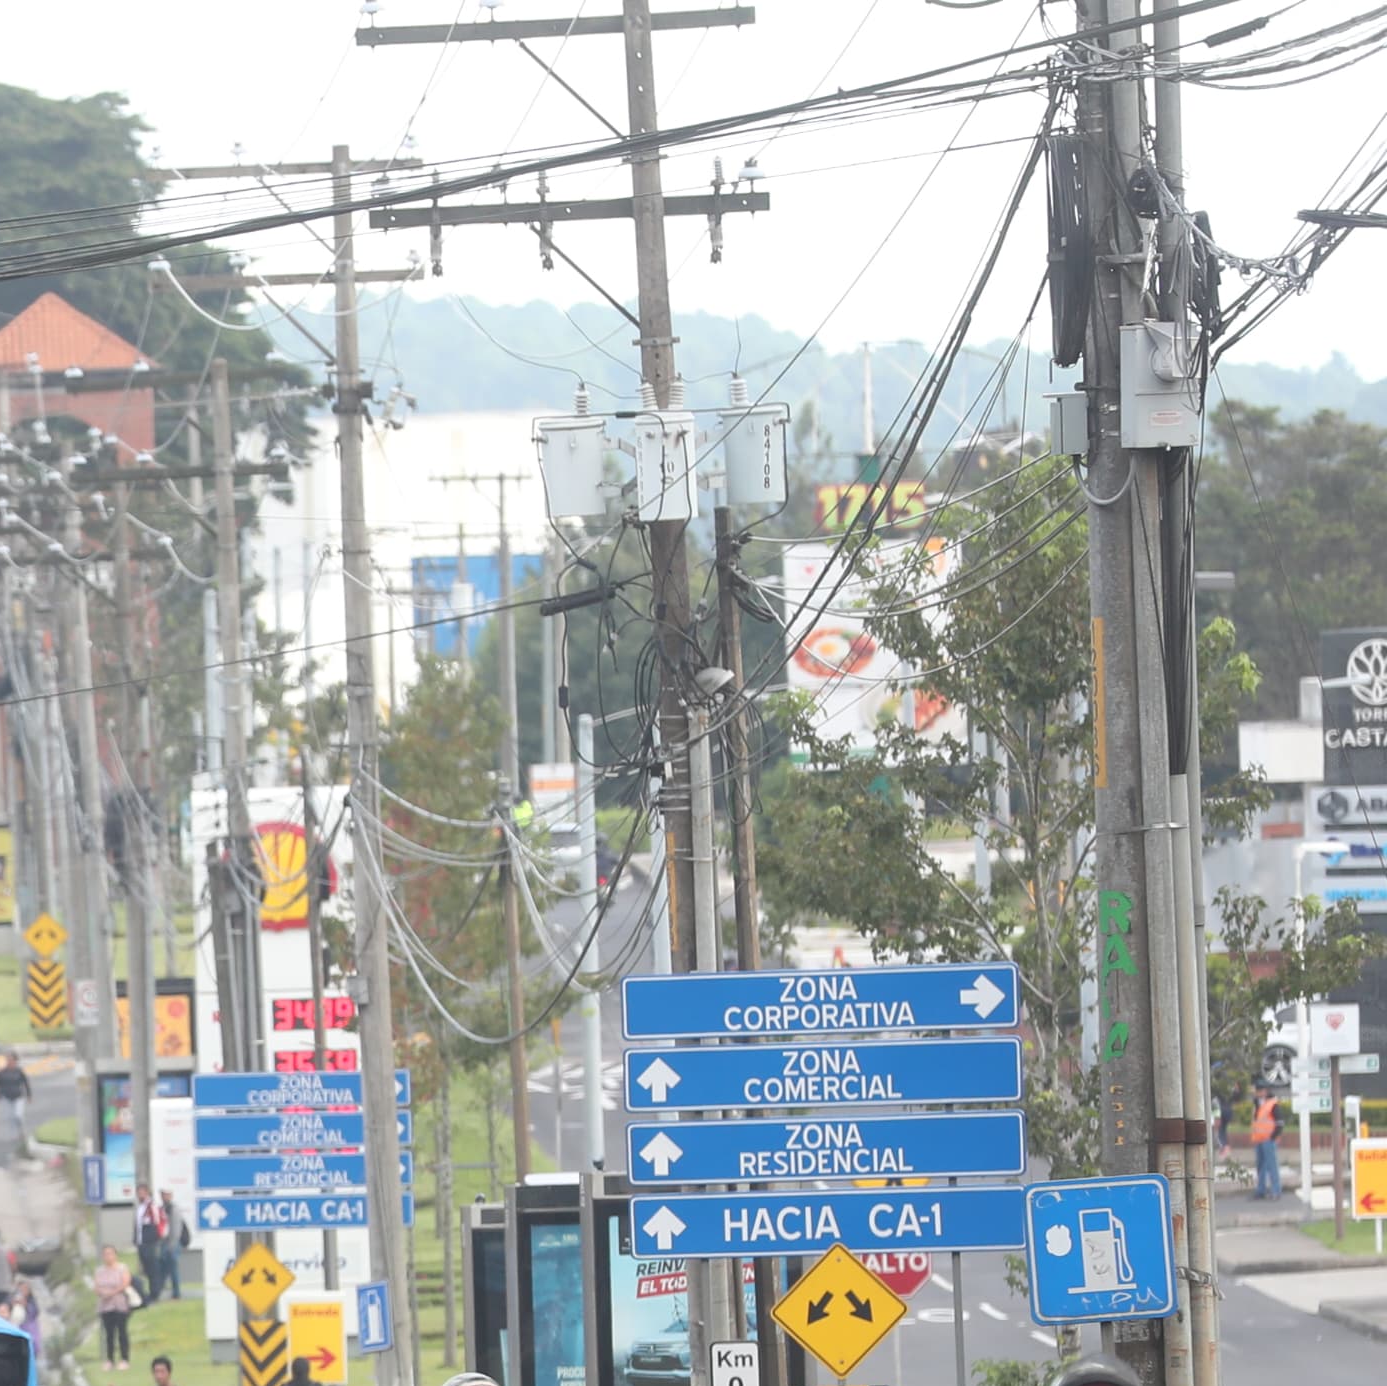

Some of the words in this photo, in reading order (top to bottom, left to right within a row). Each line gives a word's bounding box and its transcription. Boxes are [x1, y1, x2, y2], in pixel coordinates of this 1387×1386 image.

[763, 424, 771, 489] 84108
[779, 976, 857, 1002] ZONA
[724, 1001, 915, 1031] CORPORATIVA
[783, 1049, 860, 1076] ZONA
[279, 1075, 322, 1090] ZONA
[744, 1075, 902, 1102] COMERCIAL
[247, 1088, 354, 1106] CORPORATIVA
[280, 1115, 323, 1130] ZONA
[258, 1129, 346, 1146] COMERCIAL
[786, 1123, 863, 1149] ZONA
[281, 1156, 325, 1171] ZONA
[740, 1147, 913, 1176] RESIDENCIAL
[253, 1170, 352, 1187] RESIDENCIAL
[245, 1201, 312, 1223] HACIA
[321, 1200, 364, 1221] CA-1
[723, 1205, 841, 1242] HACIA
[868, 1202, 943, 1237] CA-1
[867, 1253, 928, 1272] ALTO
[640, 1278, 658, 1295] EL
[717, 1350, 754, 1368] Km
